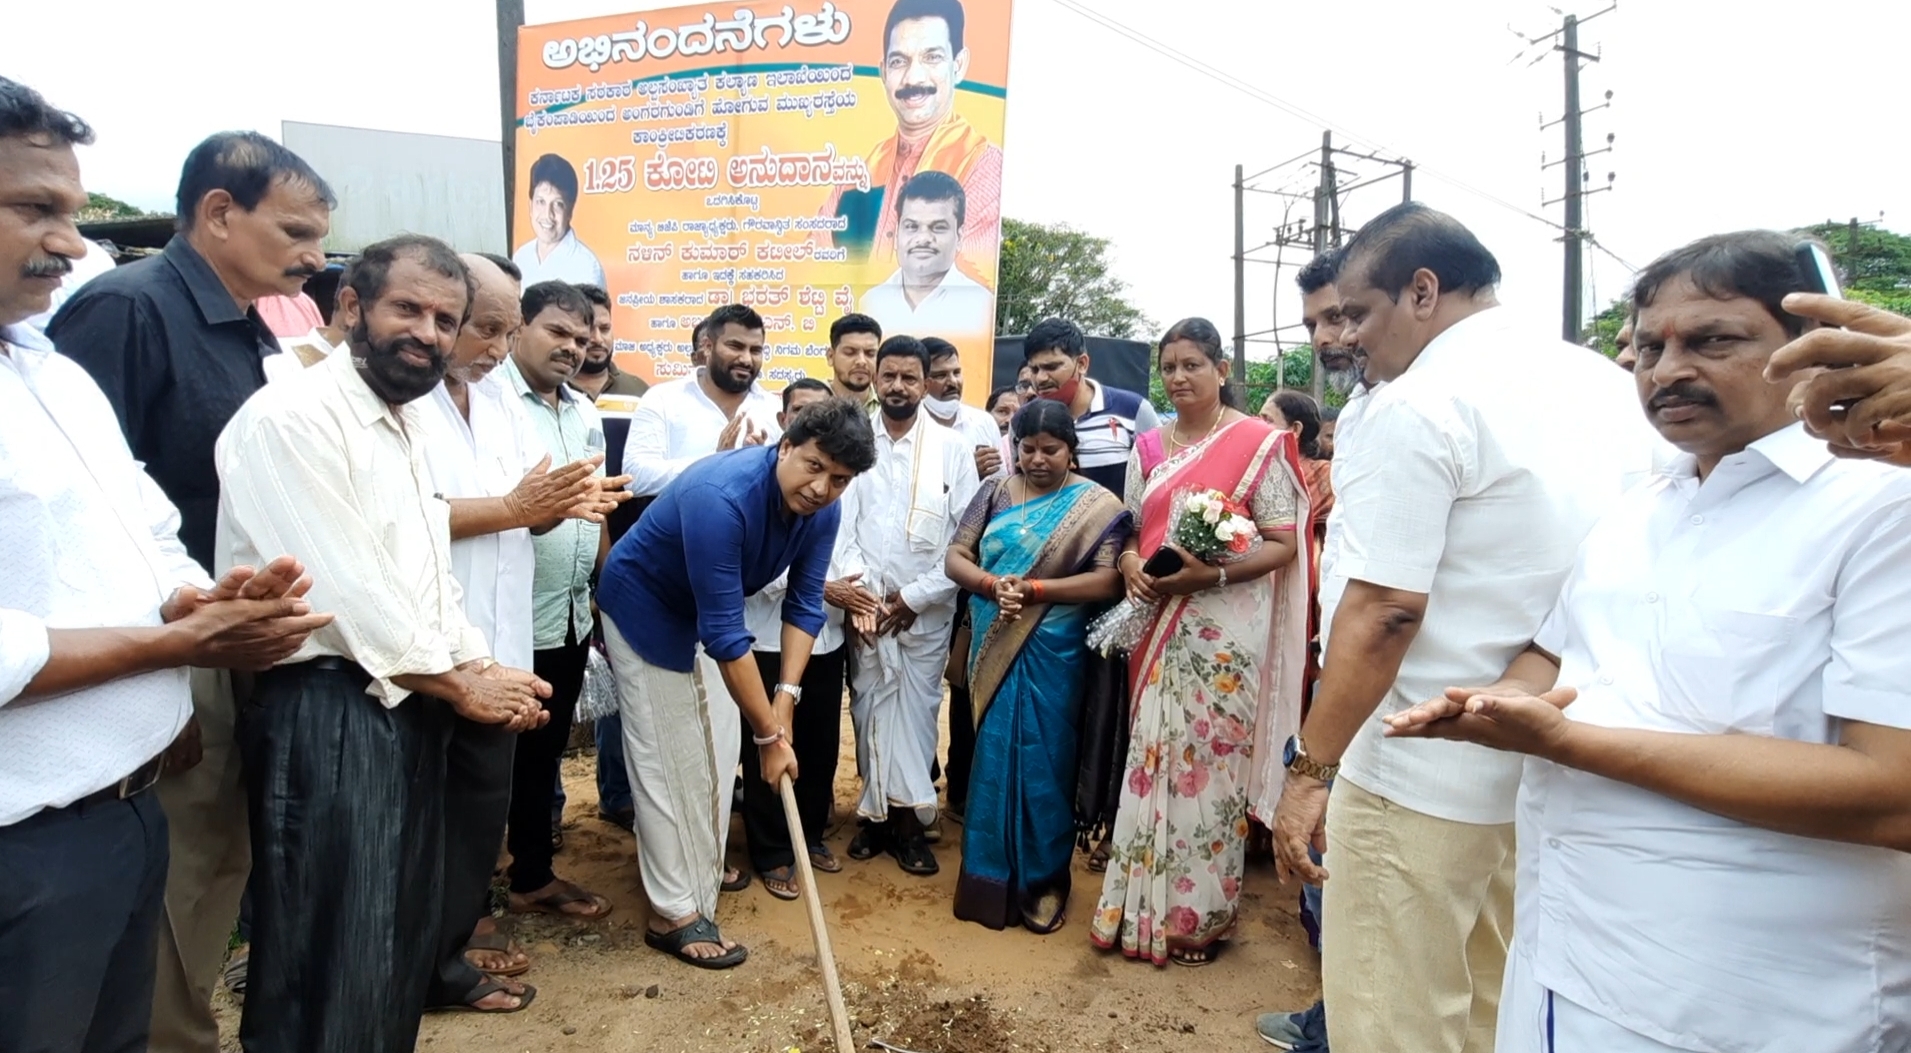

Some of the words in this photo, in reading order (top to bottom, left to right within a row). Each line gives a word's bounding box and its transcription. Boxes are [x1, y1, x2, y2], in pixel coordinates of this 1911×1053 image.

[542, 3, 850, 71] ಅಭಿನಂದನೆಗಳು
[530, 86, 580, 105] ಕರ್ನಾಟಕ
[586, 82, 632, 100] ಸರಕಾರ
[715, 73, 758, 95] ಕಲ್ಯಾಣ
[766, 64, 853, 87] ಇಲಾಖೆಯಿಂದ
[525, 108, 616, 134] ಬೈಕಂಪಾಡಿಯಿಂದ
[622, 101, 704, 121] ಅಂಗರಗುಂಡಿಗೆ
[712, 96, 769, 115] ಹೋಗುವ
[777, 89, 856, 117] ಮುಖ್ಯರಸ್ತೆಯ
[584, 158, 635, 192] 1.25
[645, 152, 718, 189] ಕೋಟಿ
[706, 194, 759, 211] ಒದಗಿಸಿಕೊಟ್ಟ
[629, 221, 654, 238] ಮಾನ್ಯ
[657, 220, 678, 232] ಬಿಜೆಪಿ
[795, 216, 846, 230] ಸಂಸದರಾದ
[628, 242, 672, 262] ನಳಿನ್
[681, 241, 748, 262] ಕುಮಾರ್
[682, 271, 708, 281] ಹಾಗೂ
[713, 269, 735, 284] ಇದಕ್ಕೆ
[738, 269, 784, 281] ಸಹಕರಿಸಿದ
[659, 292, 704, 305] ಶಾಸಕರಾದ
[741, 284, 791, 307] ಭರತ್
[798, 287, 827, 315] ಶೆಟ್ಟಿ
[835, 287, 854, 316] ವೈ
[650, 317, 676, 329] ಹಾಗೂ
[803, 317, 816, 331] ಬಿ
[639, 341, 673, 358] ಅಧ್ಯಕ್ಷರು
[775, 343, 801, 356] ನಿಗಮ
